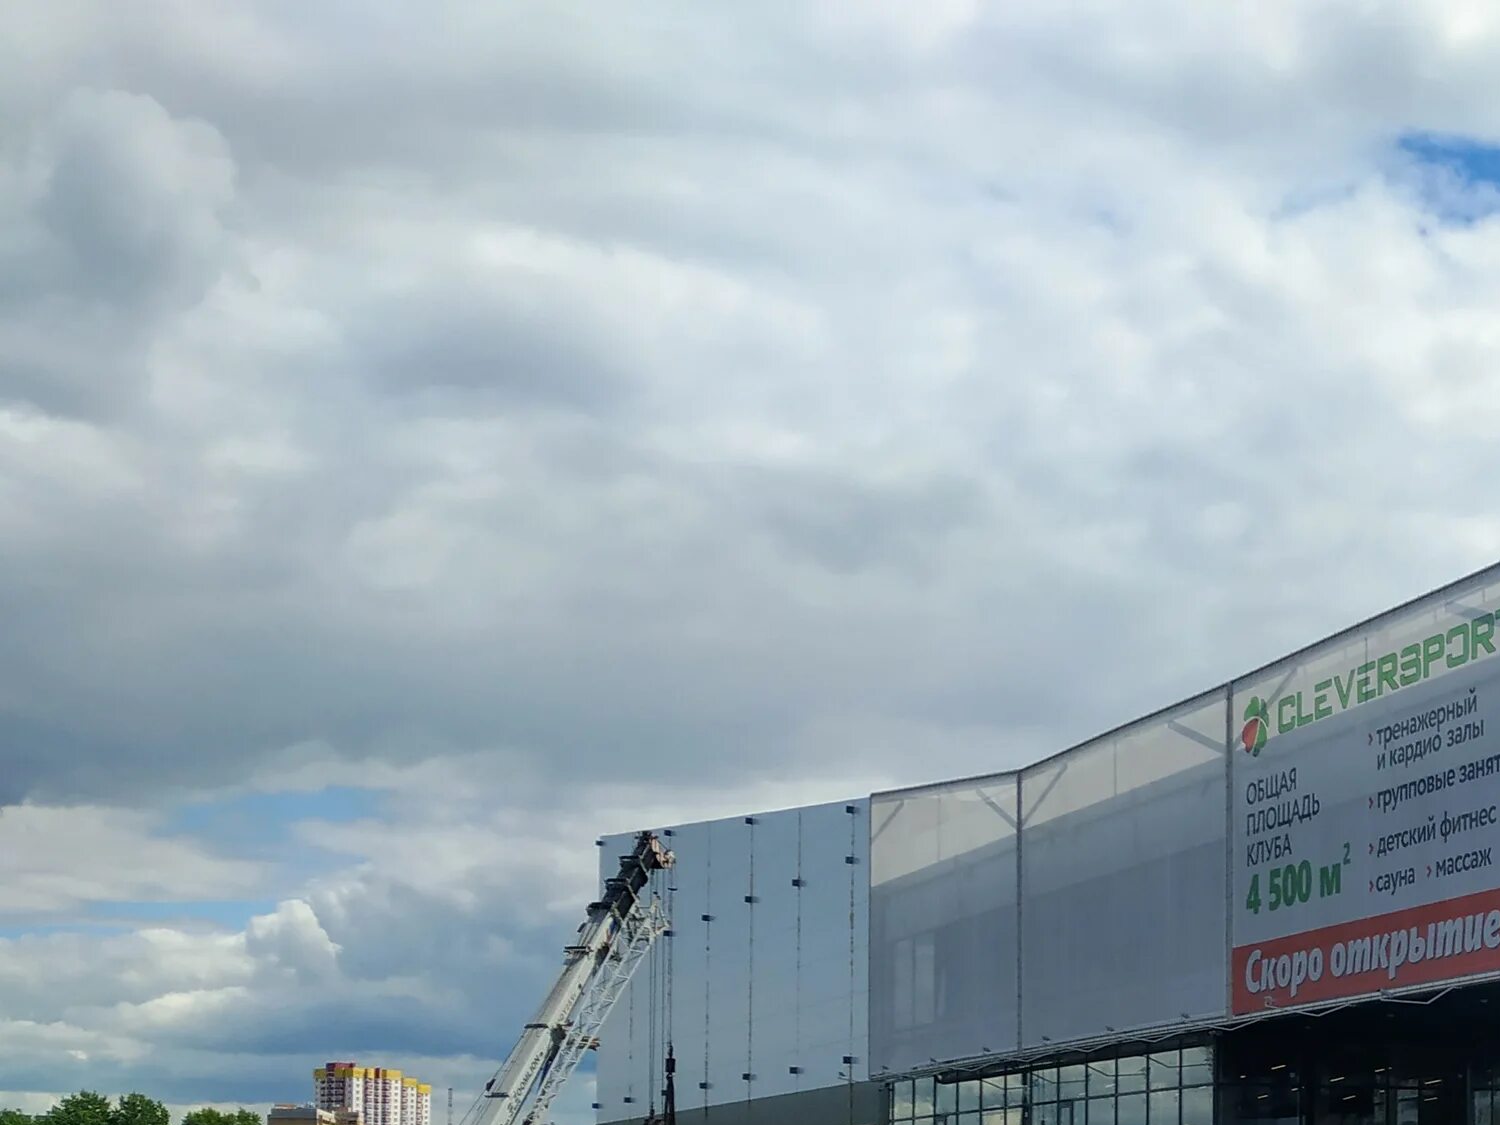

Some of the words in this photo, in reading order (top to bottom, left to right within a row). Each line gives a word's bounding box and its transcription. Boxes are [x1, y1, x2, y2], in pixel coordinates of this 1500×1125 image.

[1376, 687, 1478, 750] тренажерный
[1377, 753, 1386, 770] и
[1389, 734, 1442, 768] кардио
[1446, 719, 1485, 748] залы
[1246, 767, 1297, 805] ОБЩАЯ
[1377, 768, 1456, 813] групповые
[1246, 792, 1320, 836] ПЛОЩАДЬ
[1377, 815, 1436, 858] детский
[1440, 805, 1497, 843] фитнес
[1246, 833, 1292, 867] КЛУБА
[1376, 867, 1415, 895] сауна
[1435, 847, 1492, 878] массаж
[1246, 874, 1261, 915] 4
[1268, 859, 1312, 911] 500
[1245, 949, 1322, 998] Скоро
